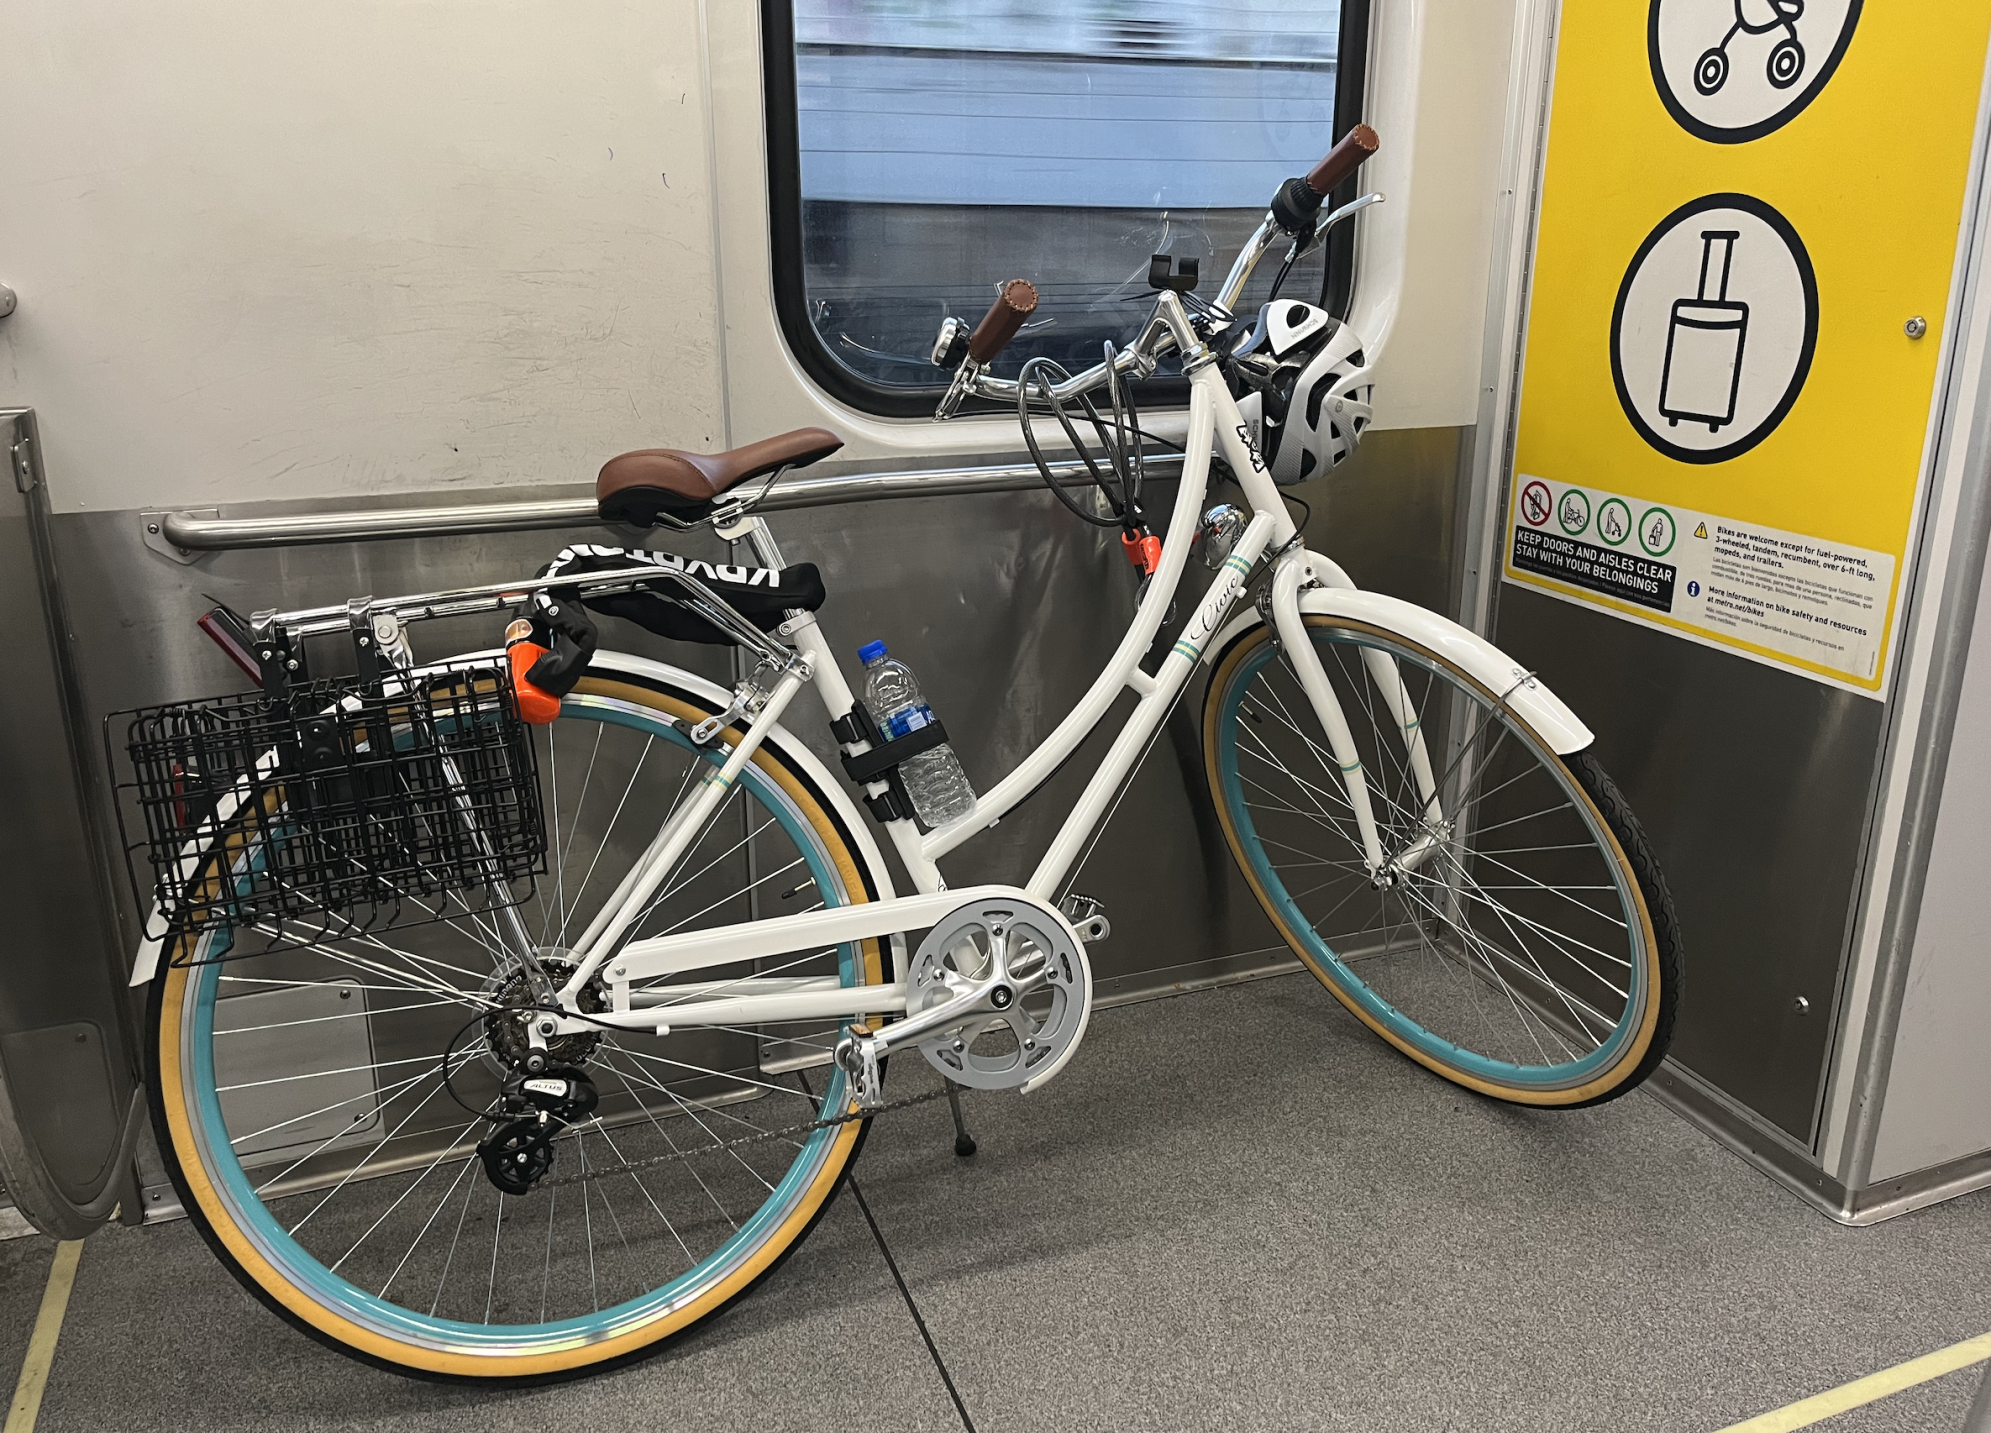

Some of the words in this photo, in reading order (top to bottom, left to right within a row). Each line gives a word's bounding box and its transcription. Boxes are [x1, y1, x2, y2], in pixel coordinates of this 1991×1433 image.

[1291, 319, 1318, 339] SCHWINN
[1518, 530, 1541, 545] KEEP
[1543, 537, 1574, 555] DOORS
[1576, 546, 1597, 561] AND
[1599, 552, 1634, 572] AISLES
[1636, 562, 1672, 582] CLEAR
[1714, 546, 1741, 558] mopeds,
[1743, 553, 1755, 562] and
[1757, 556, 1784, 568] trailers.
[1716, 536, 1751, 551] 3-wheeled,
[1753, 544, 1779, 558] tandem,
[1781, 551, 1821, 568] recumbent,
[1822, 561, 1840, 571] over
[1841, 565, 1855, 575] 6-ft
[1856, 569, 1875, 581] long,
[1717, 526, 1735, 536] Bikes
[1749, 534, 1778, 546] welcome
[1780, 541, 1802, 552] except
[1804, 546, 1815, 554] for
[1817, 548, 1868, 568] fuel-powered,
[1516, 544, 1538, 559] STAY
[1540, 550, 1563, 566] WITH
[1565, 557, 1590, 574] YOUR
[1593, 565, 1658, 594] BELONGINGS
[1191, 576, 1238, 640] Civic
[1709, 586, 1725, 596] More
[1726, 590, 1764, 607] information
[1766, 602, 1774, 610] on
[1776, 604, 1790, 614] bike
[1792, 610, 1813, 622] safety
[1814, 616, 1828, 625] and
[1830, 620, 1867, 636] resources
[1715, 598, 1764, 617] metro.net/bikes
[530, 1082, 562, 1091] ALTUS
